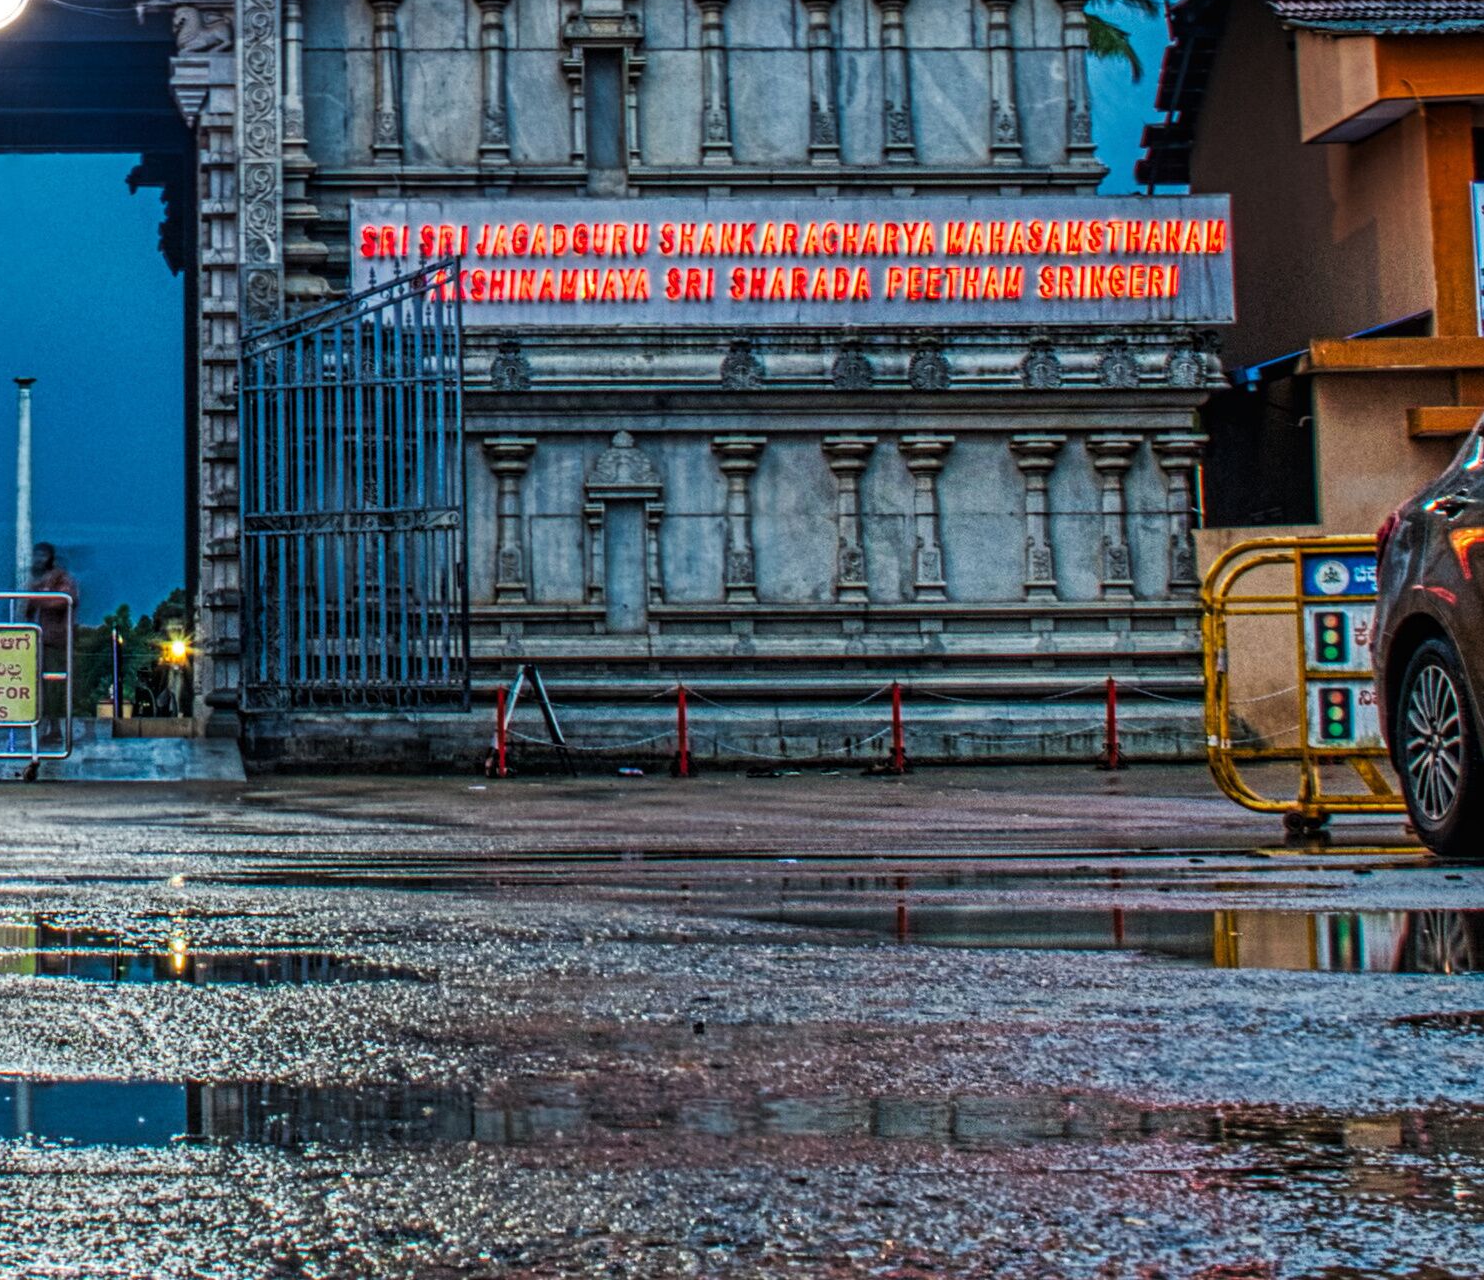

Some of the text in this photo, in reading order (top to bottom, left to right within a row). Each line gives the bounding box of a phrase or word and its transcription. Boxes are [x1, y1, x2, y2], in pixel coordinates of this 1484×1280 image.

[360, 219, 1227, 258] SRI SRI JAGADGURU SHANKARACHARYA MAHASAMSTHANAM
[421, 265, 1179, 302] AKSHINAMNAYA SRI SHARADA PEETHAM SRINGERI
